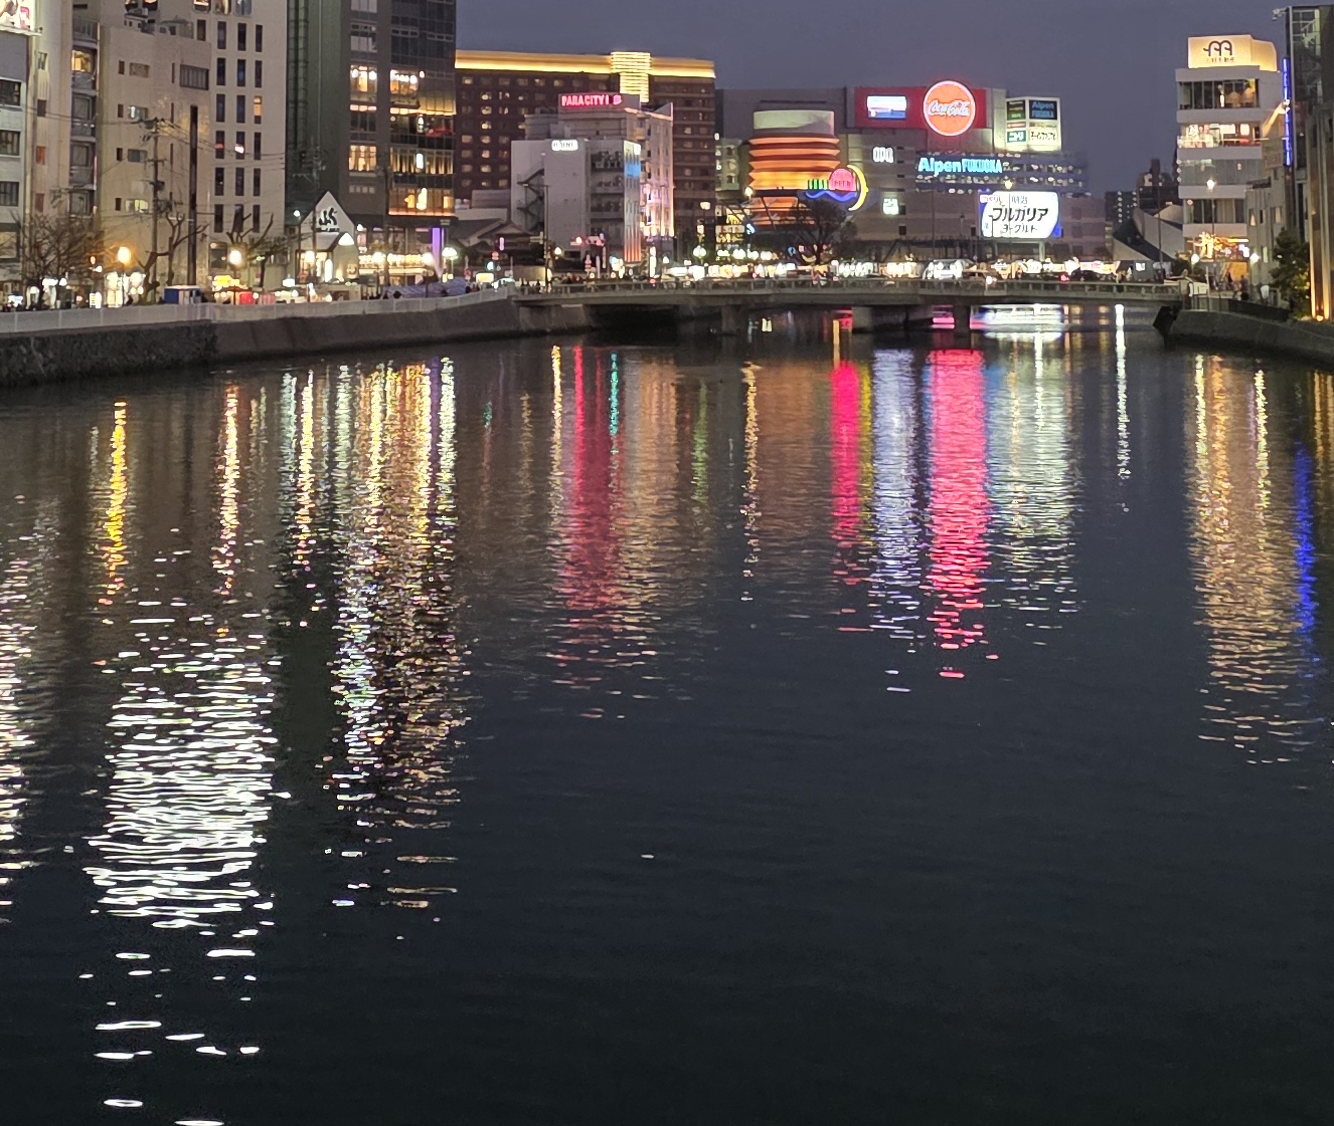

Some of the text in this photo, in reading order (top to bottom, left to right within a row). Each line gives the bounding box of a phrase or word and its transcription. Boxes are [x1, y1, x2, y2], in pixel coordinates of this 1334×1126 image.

[918, 158, 961, 177] Alpen
[992, 204, 1049, 222] ブルガリア
